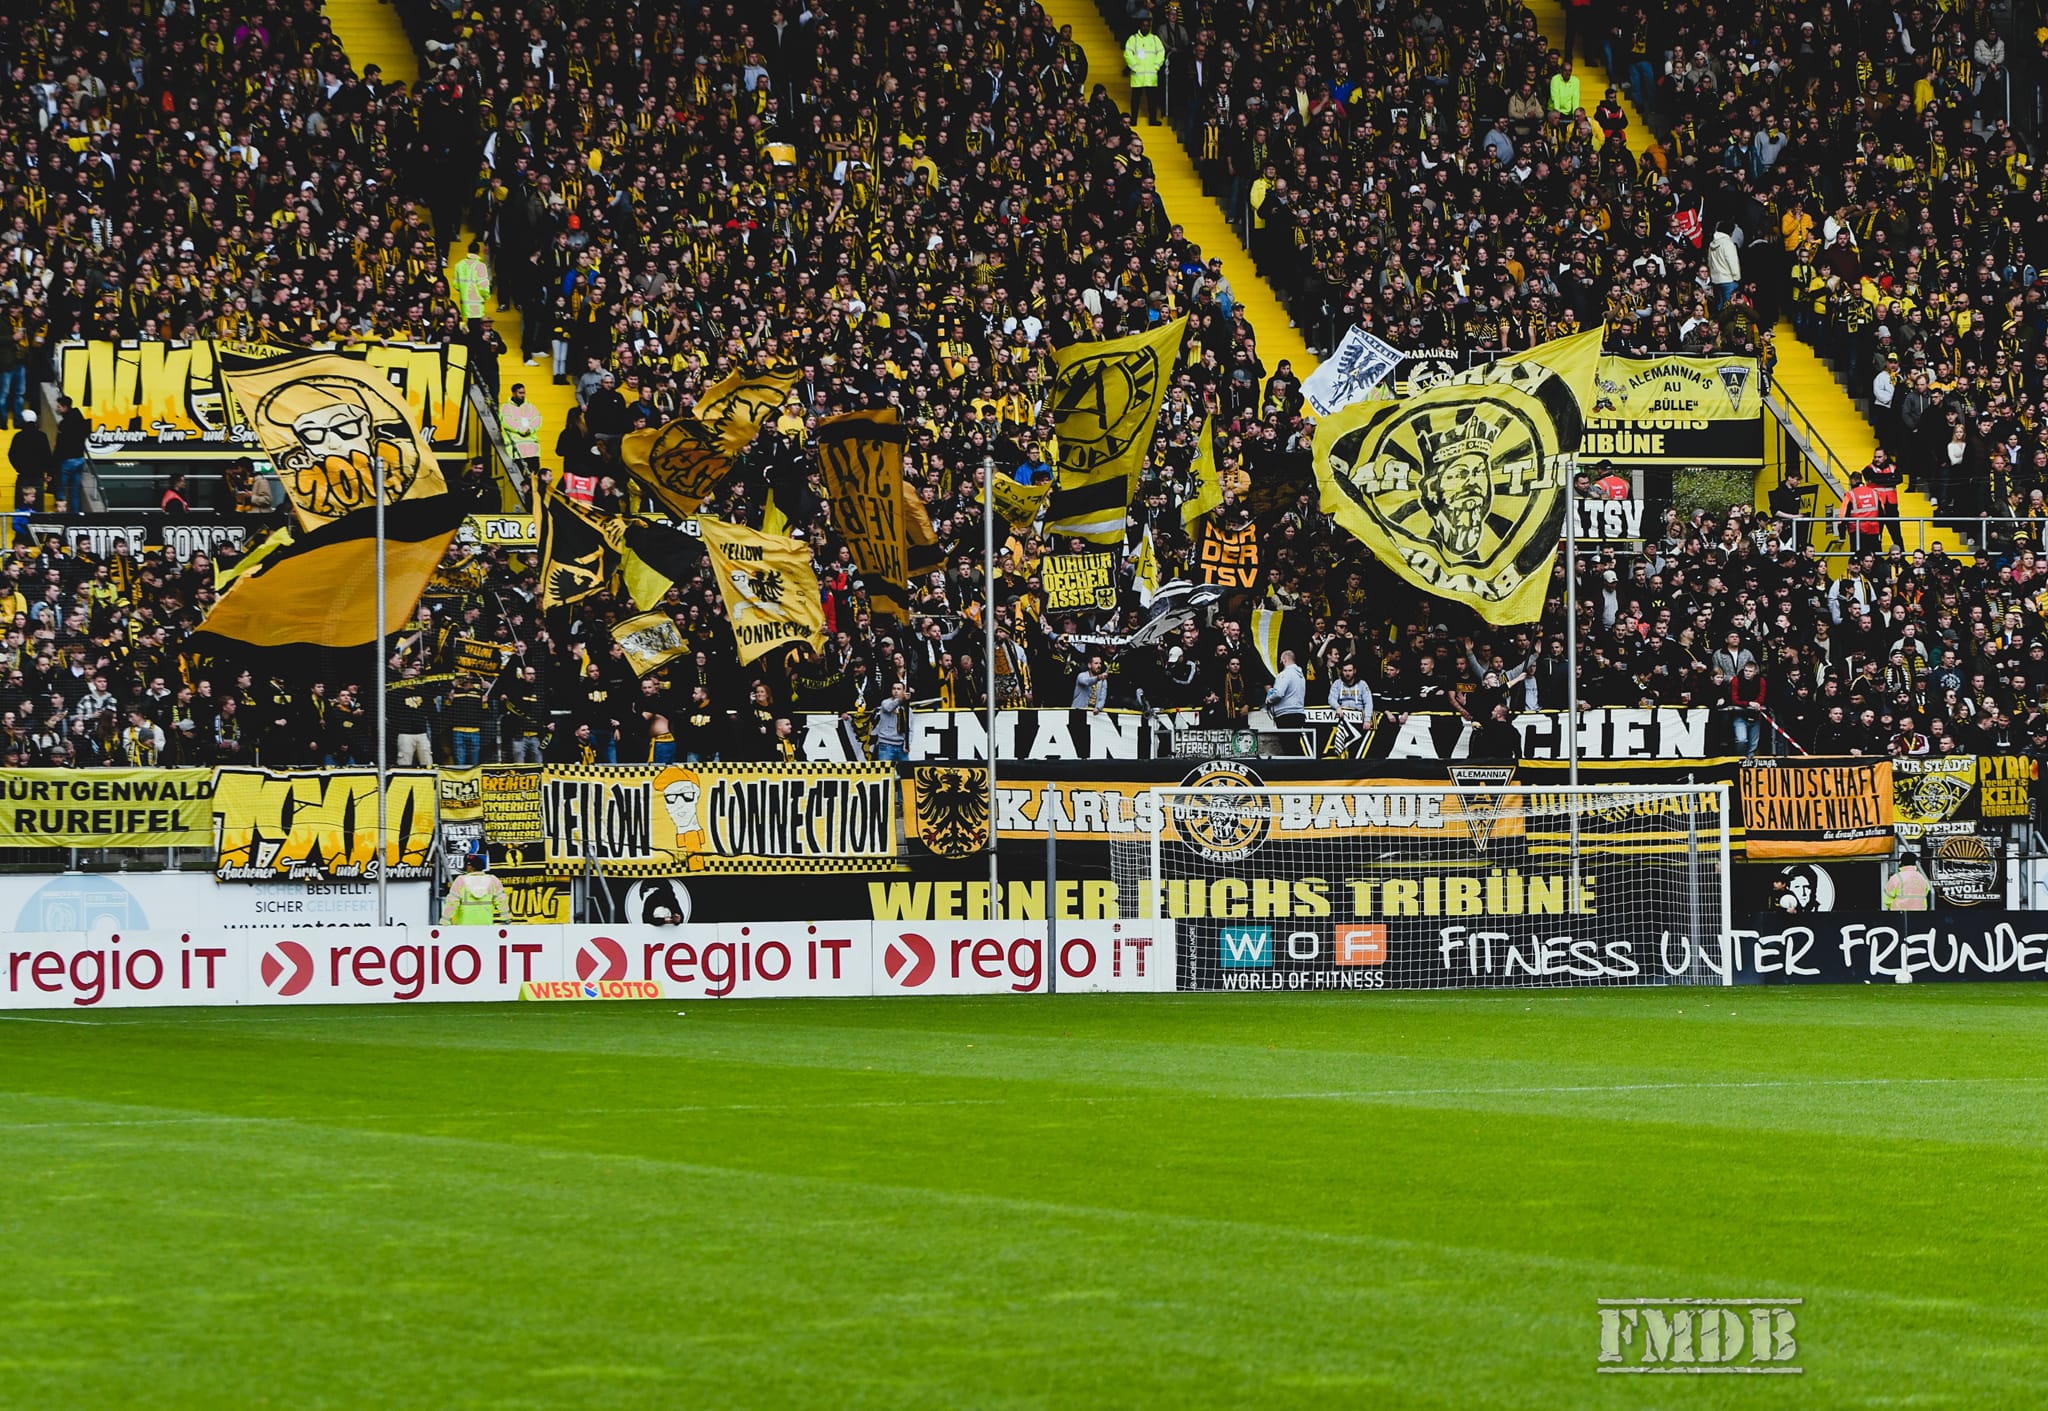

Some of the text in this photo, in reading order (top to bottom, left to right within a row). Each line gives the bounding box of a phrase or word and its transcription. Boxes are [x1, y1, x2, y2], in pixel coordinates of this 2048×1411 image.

[1628, 365, 1713, 391] ALEMANNIA'S
[1664, 382, 1681, 392] AU
[202, 426, 227, 443] und
[486, 519, 523, 539] FÜR
[1201, 539, 1259, 565] DER
[1200, 563, 1259, 589] TSV
[1047, 588, 1096, 609] ASSIS
[1175, 730, 1233, 742] LEGENDEN
[1198, 761, 1249, 777] KARLS
[1456, 770, 1508, 779] ALEMANNIA
[1924, 758, 1971, 773] STADT
[1978, 755, 2030, 780] PYRO
[482, 775, 538, 792] FREIHEIT
[1981, 786, 2030, 806] KEIN
[484, 801, 540, 812] SICHERHEIT
[1280, 792, 1445, 831] BANDE
[14, 808, 190, 834] RUREIFEL
[543, 778, 890, 859] YELLOW CONNECTION
[1923, 821, 1976, 835] VEREIN
[1200, 847, 1251, 862] BANDE
[336, 862, 361, 877] und
[306, 883, 372, 895] BESTELLT.
[1345, 868, 1598, 917] TRIBÜNE
[1942, 884, 1984, 897] TIVOLI
[255, 901, 303, 913] SICHER
[1439, 925, 1640, 977] FITNESS
[1839, 922, 2048, 976] FREUNDE
[10, 934, 164, 1006] regio
[331, 928, 482, 1000] regio
[644, 926, 792, 997] regio
[951, 938, 1097, 992] rego
[527, 980, 660, 1000] WEST LOTTO
[1222, 971, 1384, 990] WORLD OF FITNESS
